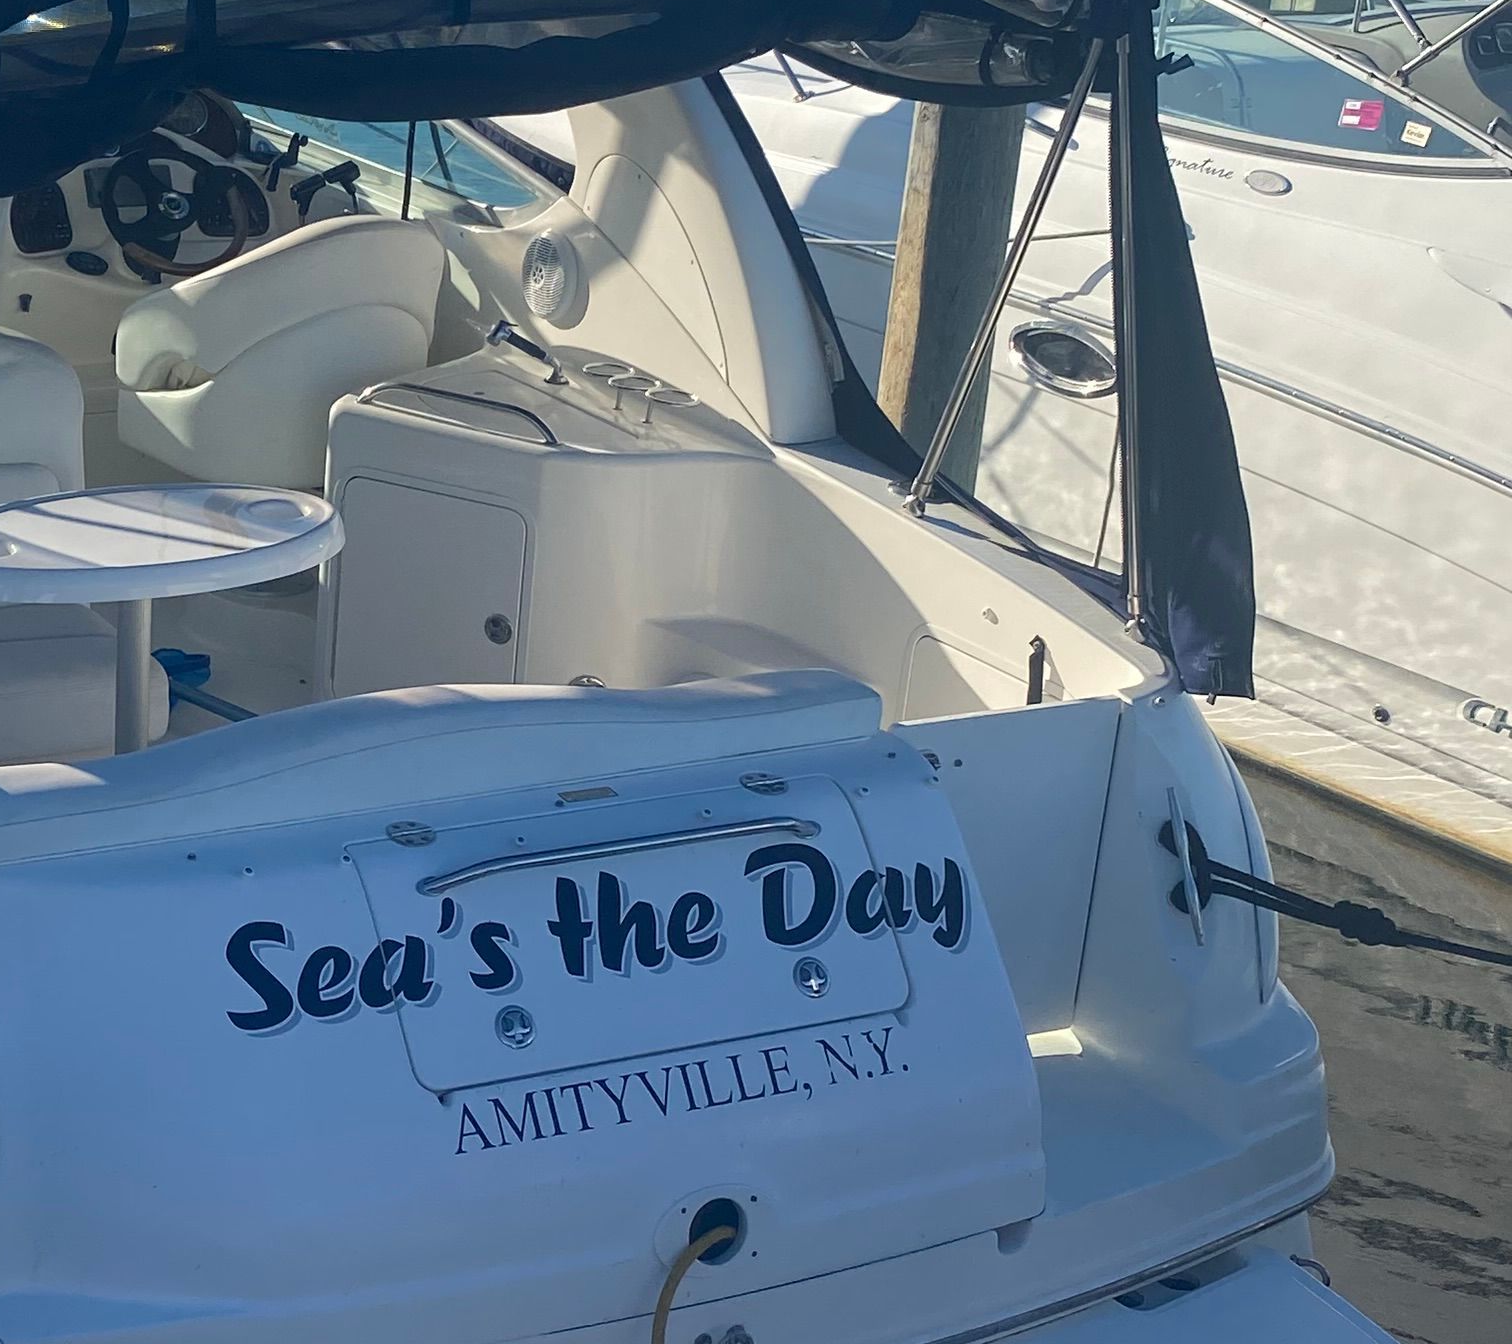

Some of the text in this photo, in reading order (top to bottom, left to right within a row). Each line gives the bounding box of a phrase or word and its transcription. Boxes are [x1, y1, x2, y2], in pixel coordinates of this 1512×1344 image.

[225, 842, 966, 1036] Sea's the Day
[453, 1027, 910, 1155] AMITYVILLE, N.Y.
